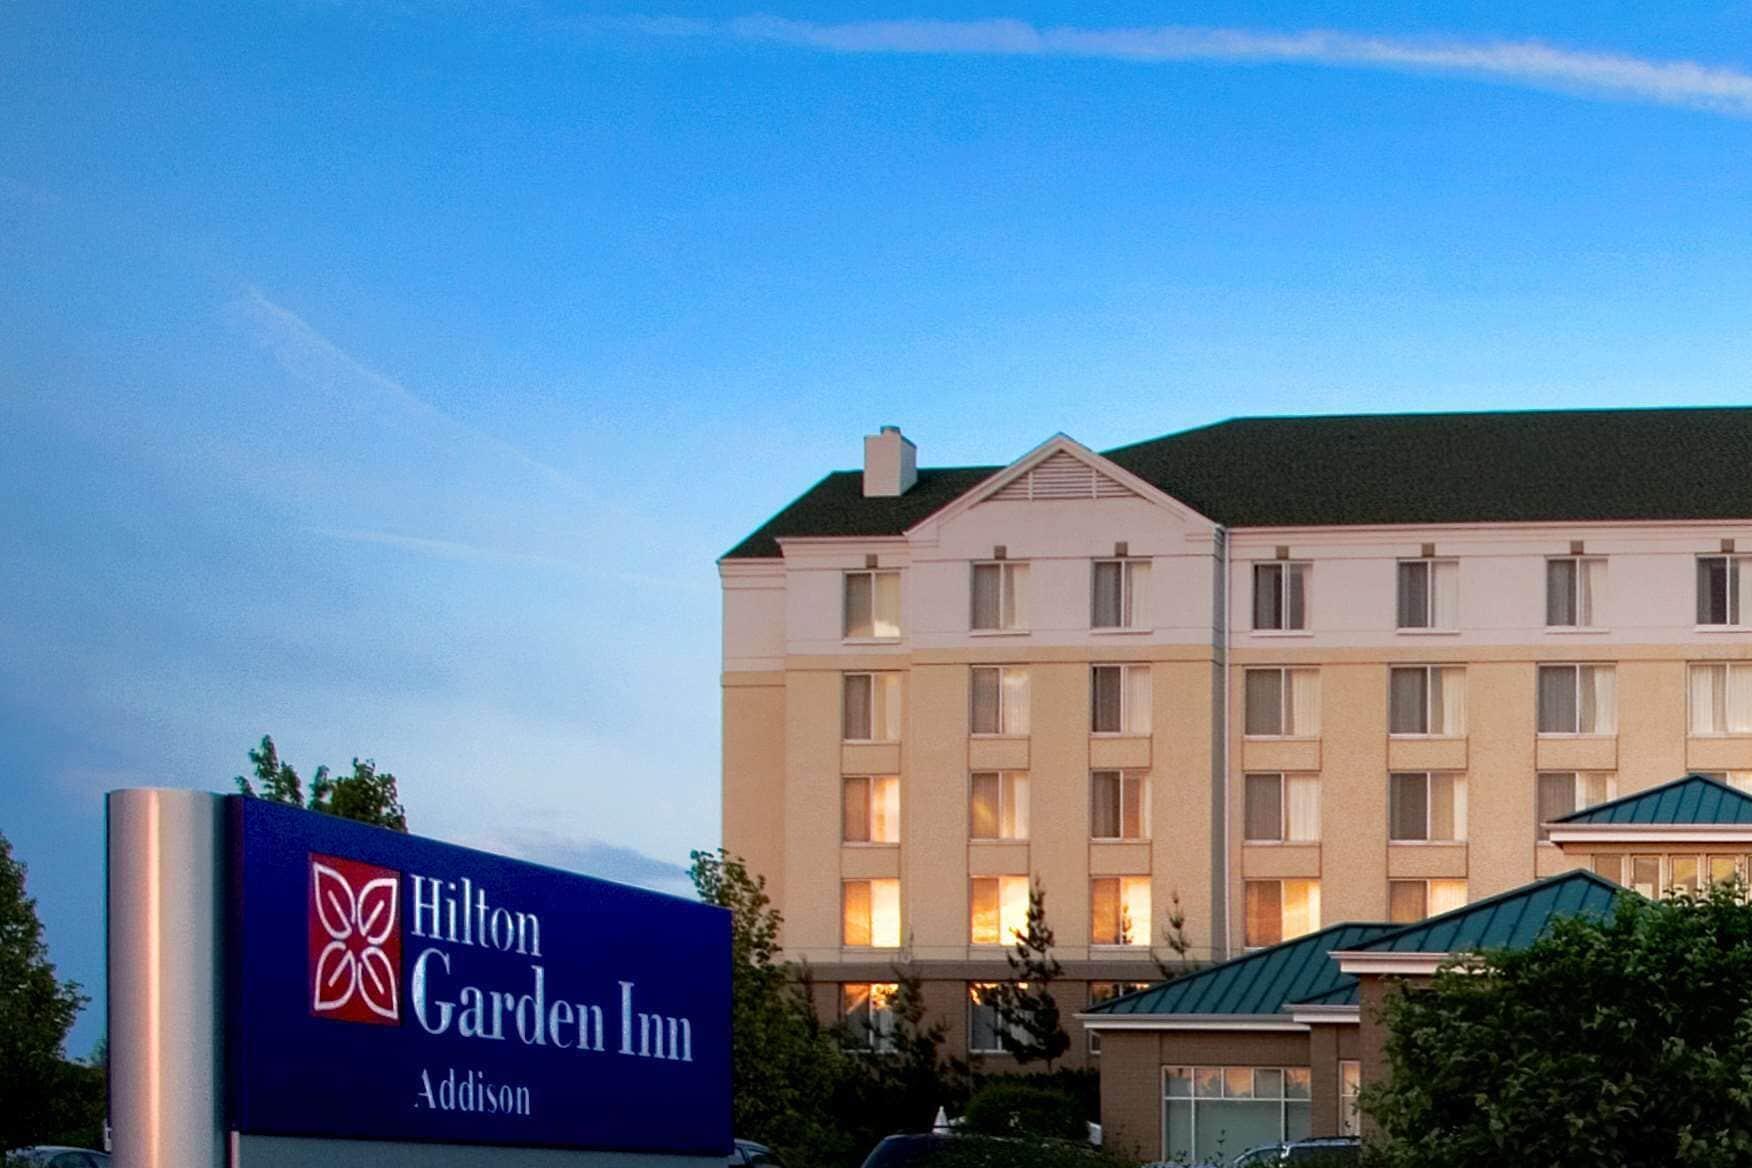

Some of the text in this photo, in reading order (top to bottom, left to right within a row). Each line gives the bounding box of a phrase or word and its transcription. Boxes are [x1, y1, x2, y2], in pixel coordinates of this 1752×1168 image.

[410, 873, 543, 957] Hilton
[411, 947, 693, 1062] Garden Inn
[413, 1067, 531, 1116] Addison
